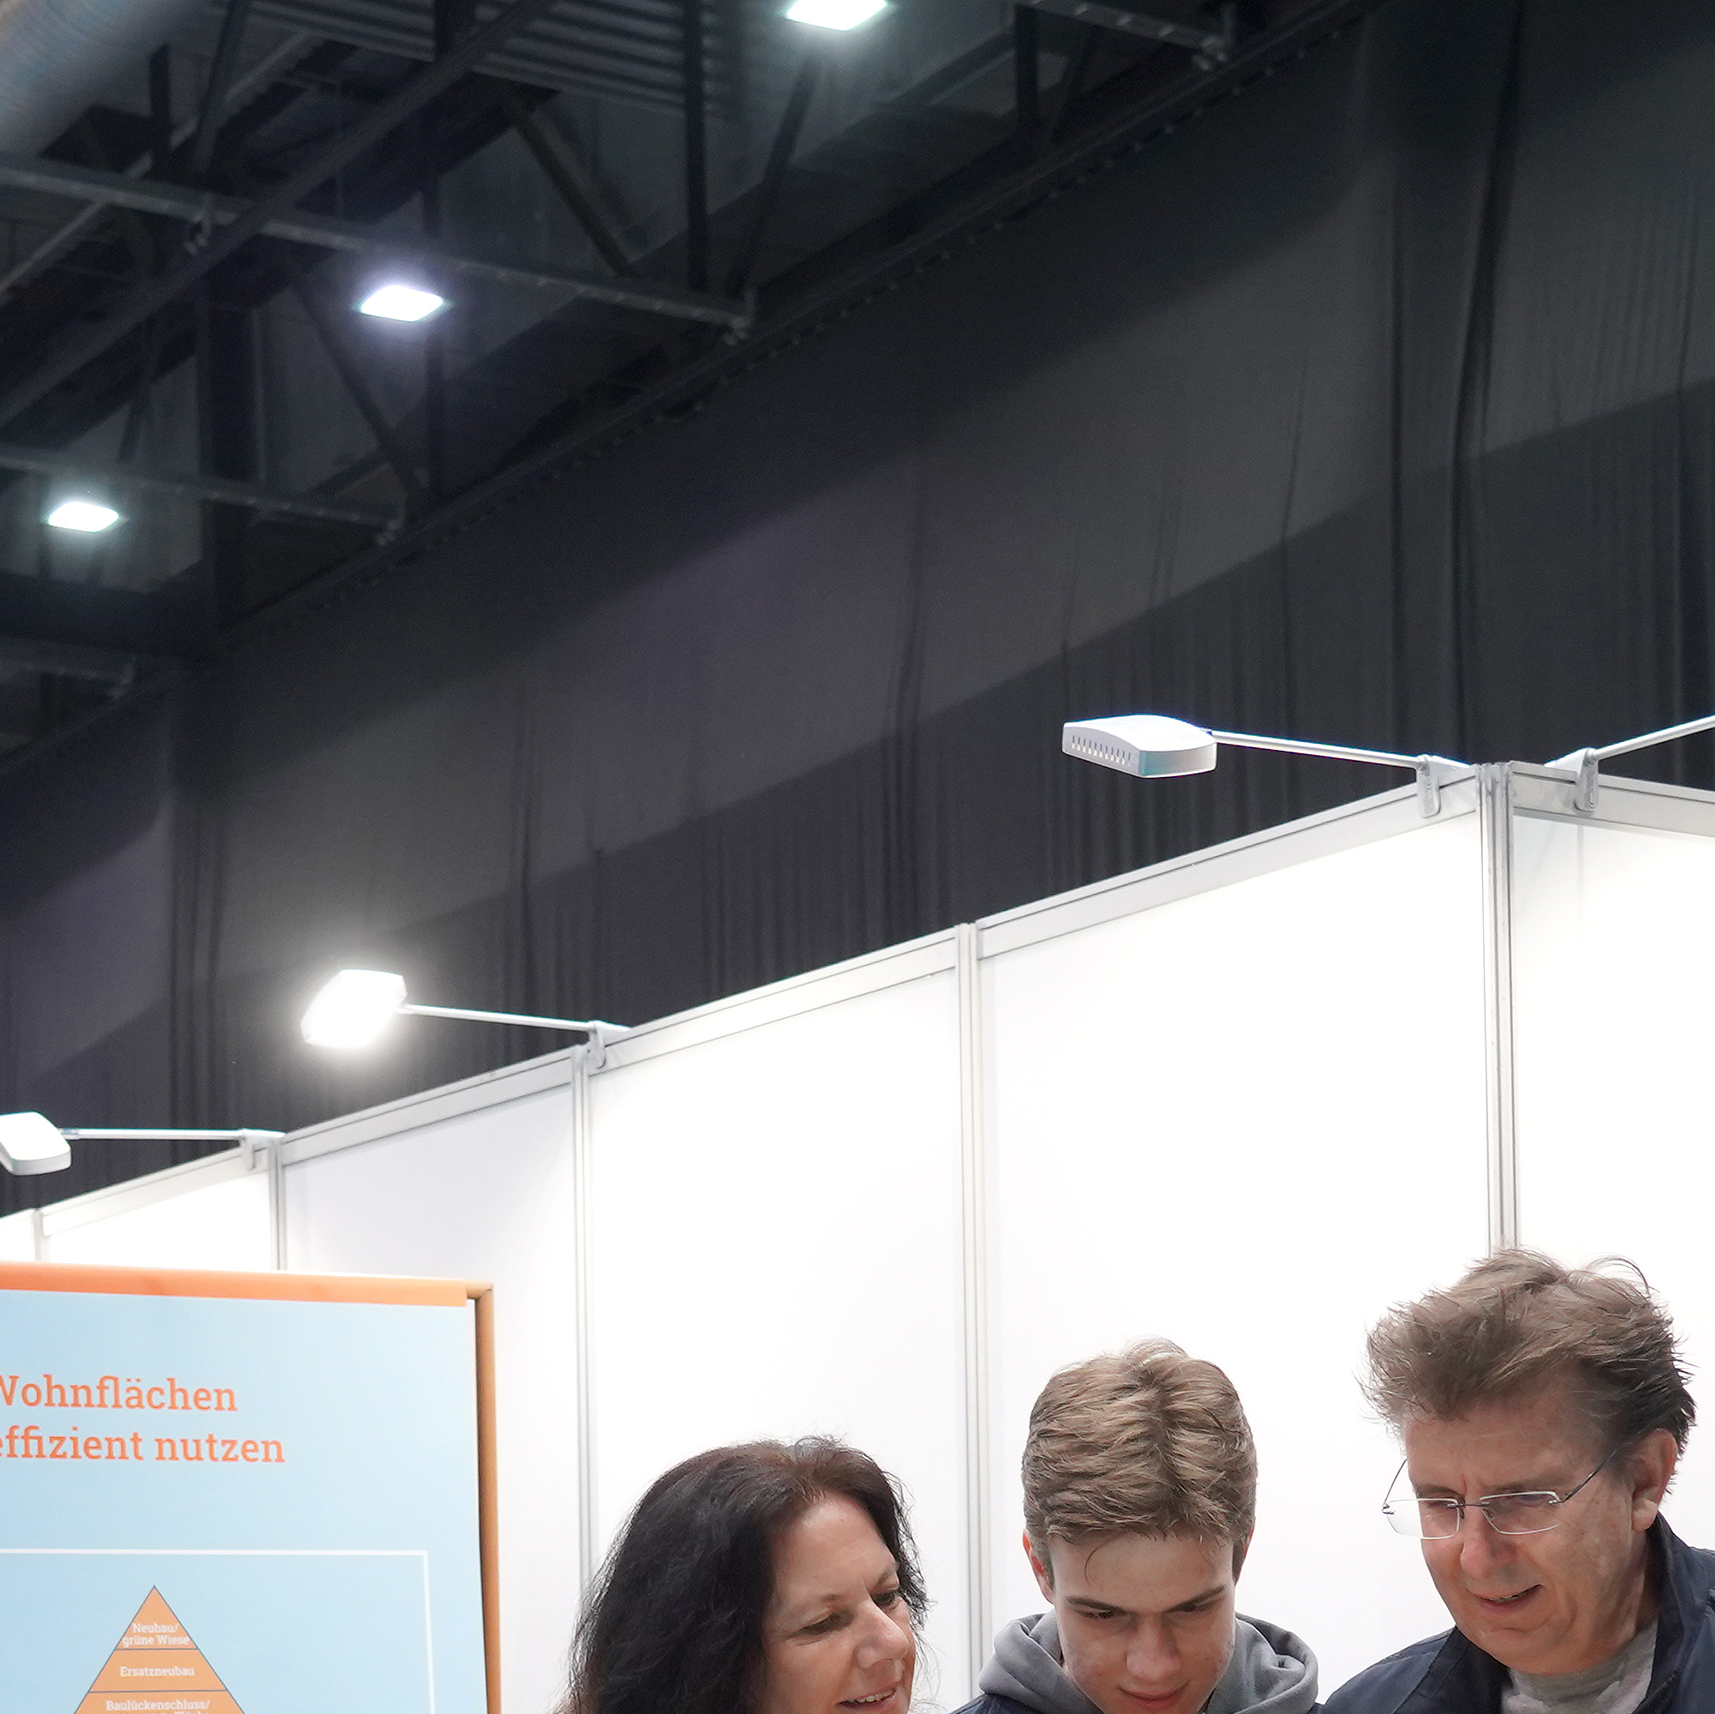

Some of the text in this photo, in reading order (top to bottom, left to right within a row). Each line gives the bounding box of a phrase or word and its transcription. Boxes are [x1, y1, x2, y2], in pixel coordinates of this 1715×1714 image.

[154, 1434, 285, 1462] nutzen
[157, 1634, 190, 1645] Wiese
[120, 1666, 195, 1677] Ersatzneubau
